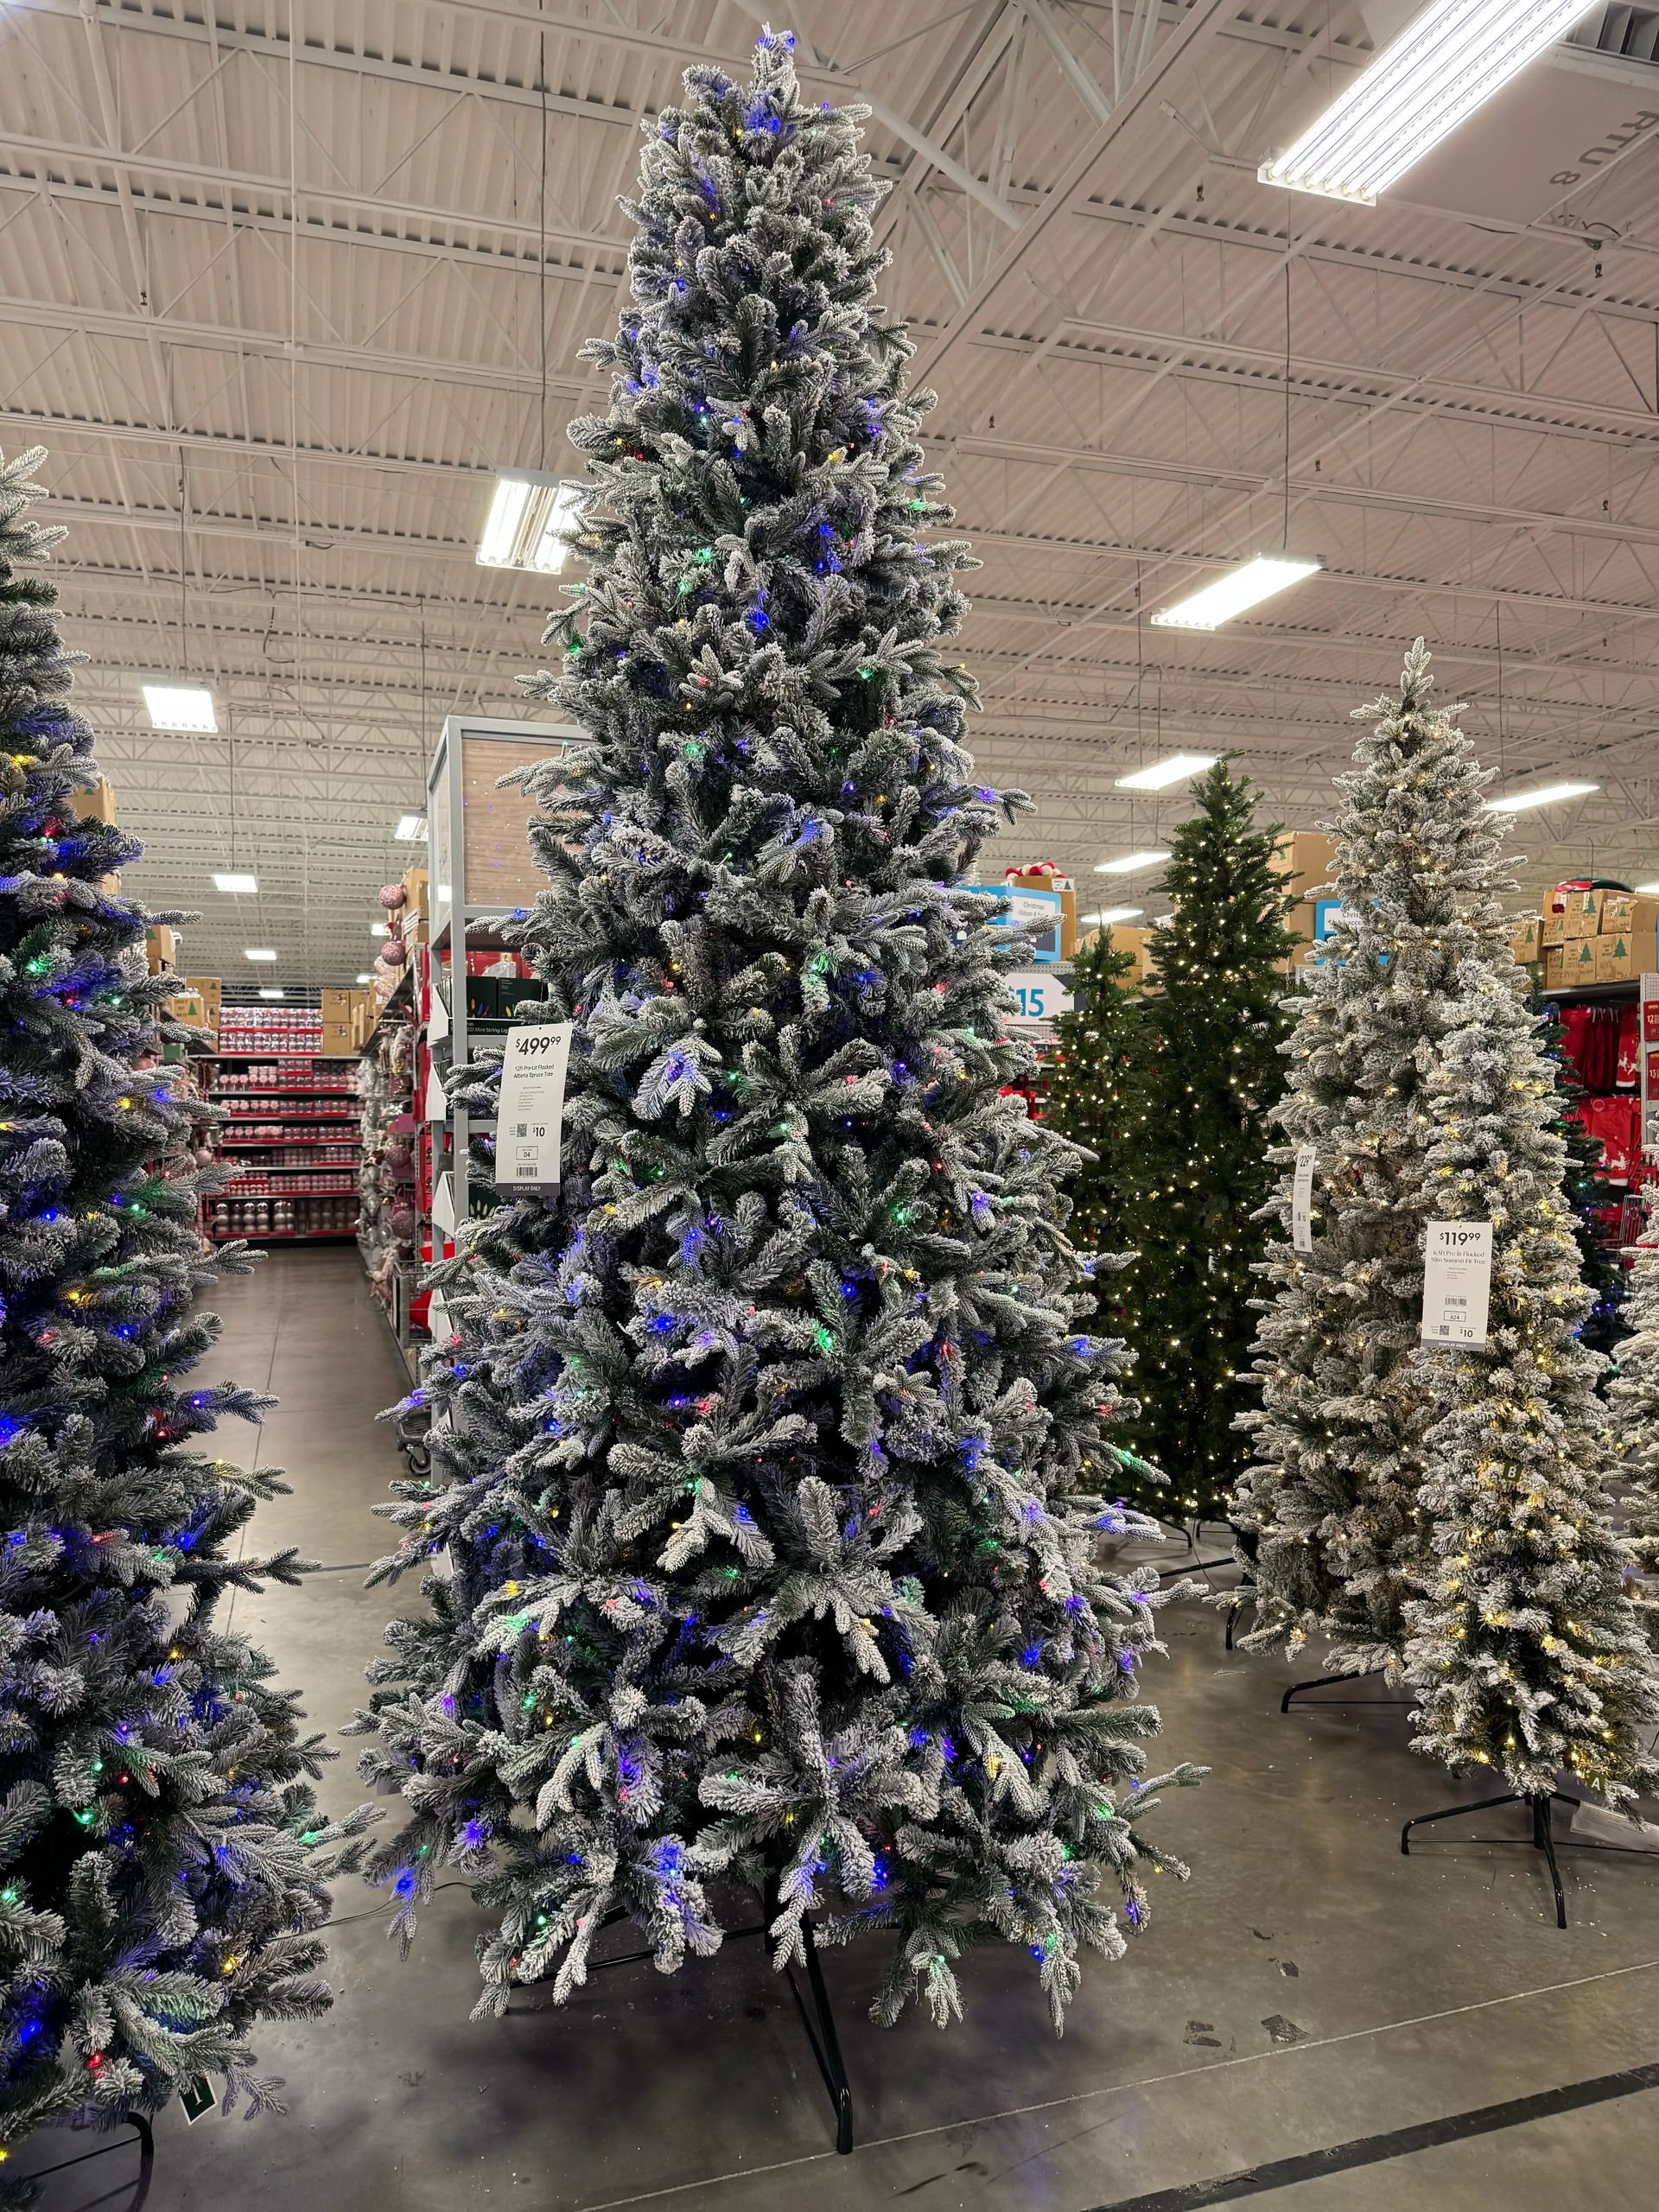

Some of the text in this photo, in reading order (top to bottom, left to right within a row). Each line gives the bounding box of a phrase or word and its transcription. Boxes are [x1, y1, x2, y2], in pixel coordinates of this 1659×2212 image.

[1549, 170, 1581, 185] 8
[1023, 901, 1045, 910] Christmas
[532, 1127, 545, 1137] $10
[1459, 1329, 1473, 1338] $10
[1508, 1465, 1517, 1478] B
[1591, 1777, 1601, 1791] A
